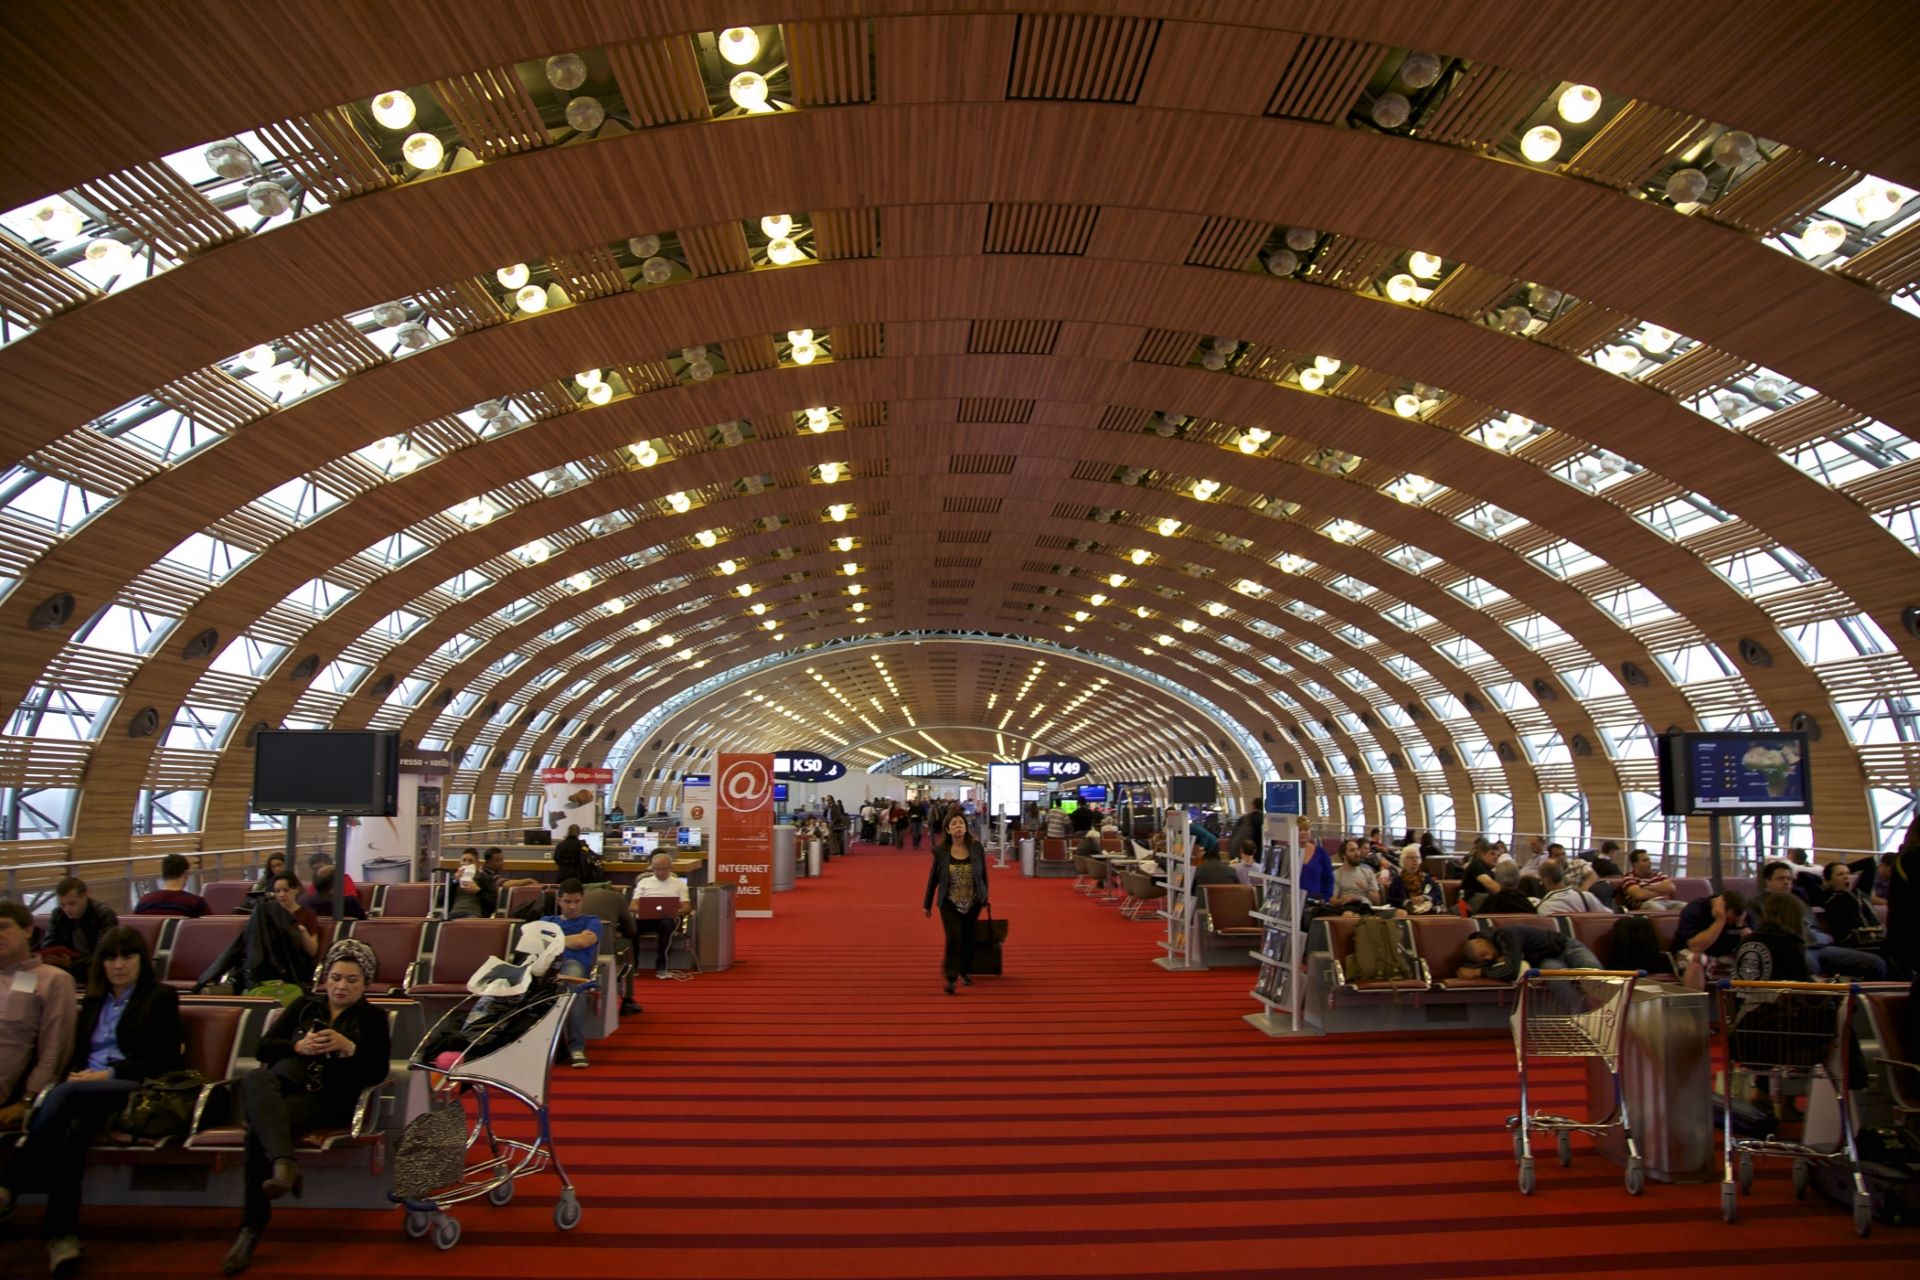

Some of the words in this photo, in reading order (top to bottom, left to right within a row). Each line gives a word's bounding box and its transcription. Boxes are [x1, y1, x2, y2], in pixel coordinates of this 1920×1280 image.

[400, 758, 423, 766] resso
[793, 758, 822, 772] K50
[1052, 762, 1081, 775] K49
[718, 864, 770, 873] INTERNET
[738, 874, 749, 884] &
[736, 886, 761, 895] MES
